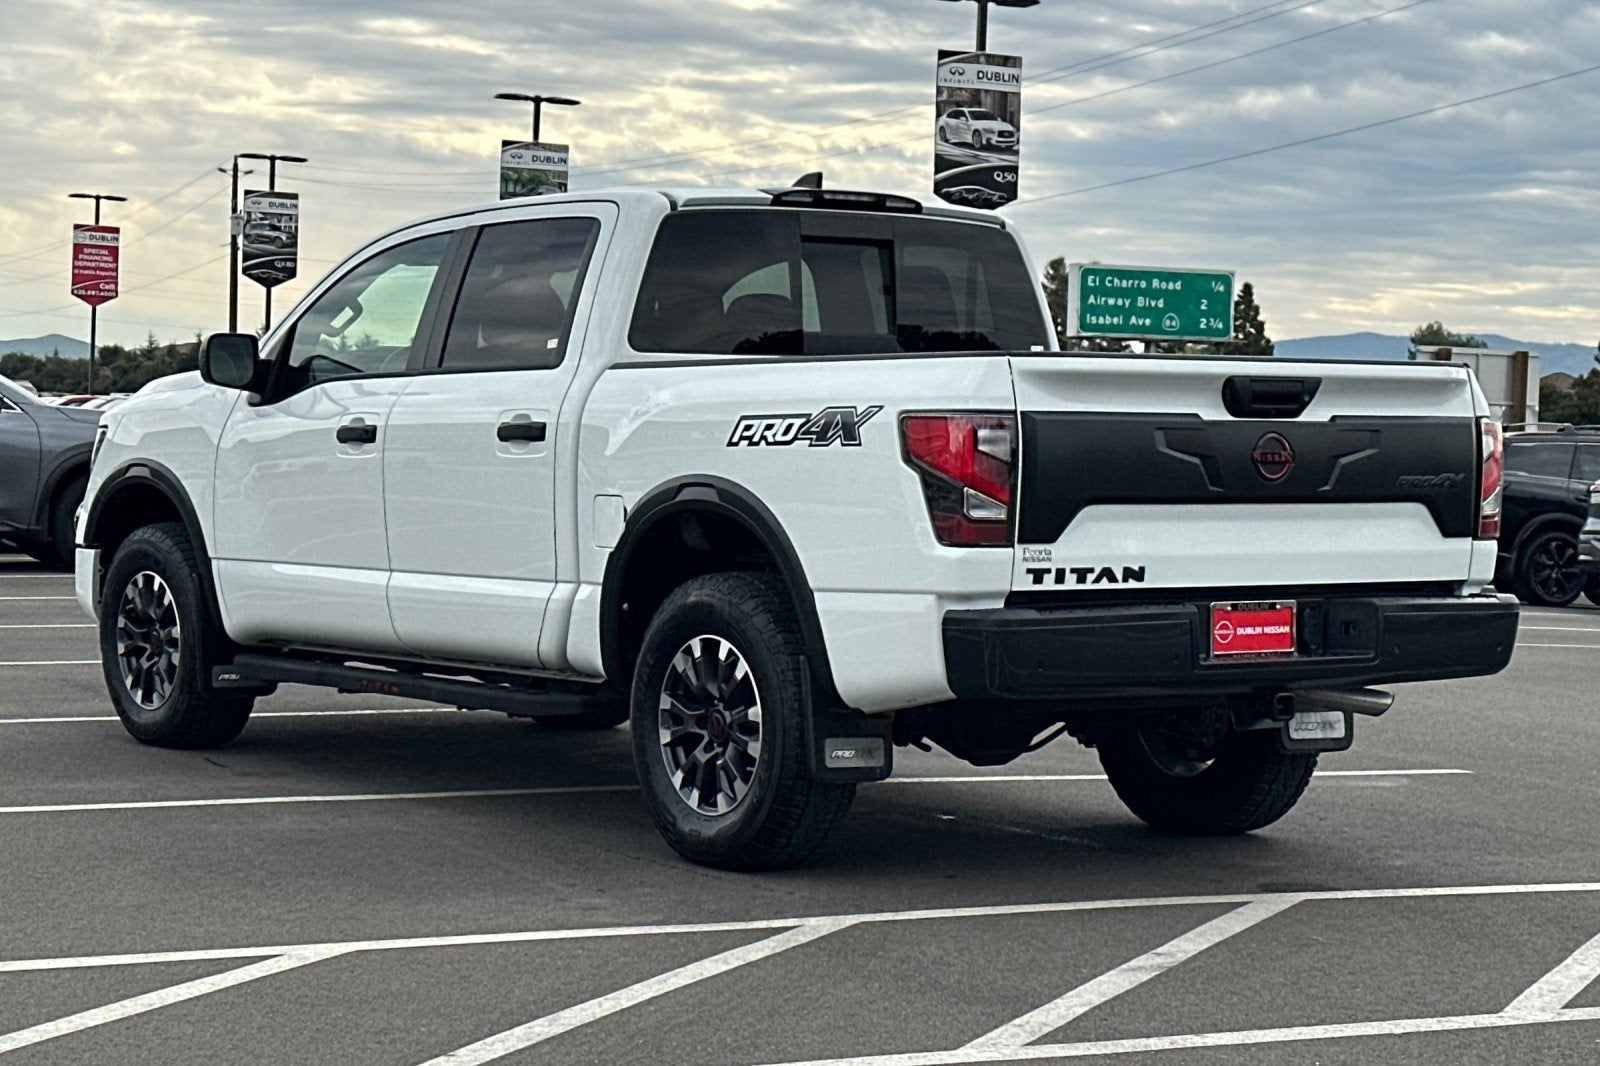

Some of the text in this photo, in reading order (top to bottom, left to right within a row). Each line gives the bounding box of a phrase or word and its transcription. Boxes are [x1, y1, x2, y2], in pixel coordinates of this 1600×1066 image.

[977, 70, 1020, 84] DUBLIN
[531, 154, 567, 165] DUBLIN
[993, 171, 1017, 183] Q50
[268, 201, 298, 210] DUBLIN
[88, 233, 119, 242] DUBLIN
[83, 247, 109, 255] SPECIAL
[78, 254, 114, 262] FINANCING
[74, 260, 117, 269] DEPARTMENT
[1087, 275, 1225, 292] El Charro Road 1/4
[1087, 294, 1208, 310] Airway Blvd 2
[1086, 313, 1123, 325] Isabel
[1129, 315, 1152, 326] Ave
[1252, 450, 1294, 463] NISSAN
[1026, 565, 1146, 585] TITAN
[1237, 602, 1270, 610] DUBLIN
[1236, 625, 1290, 635] DUBLIN NISSAN
